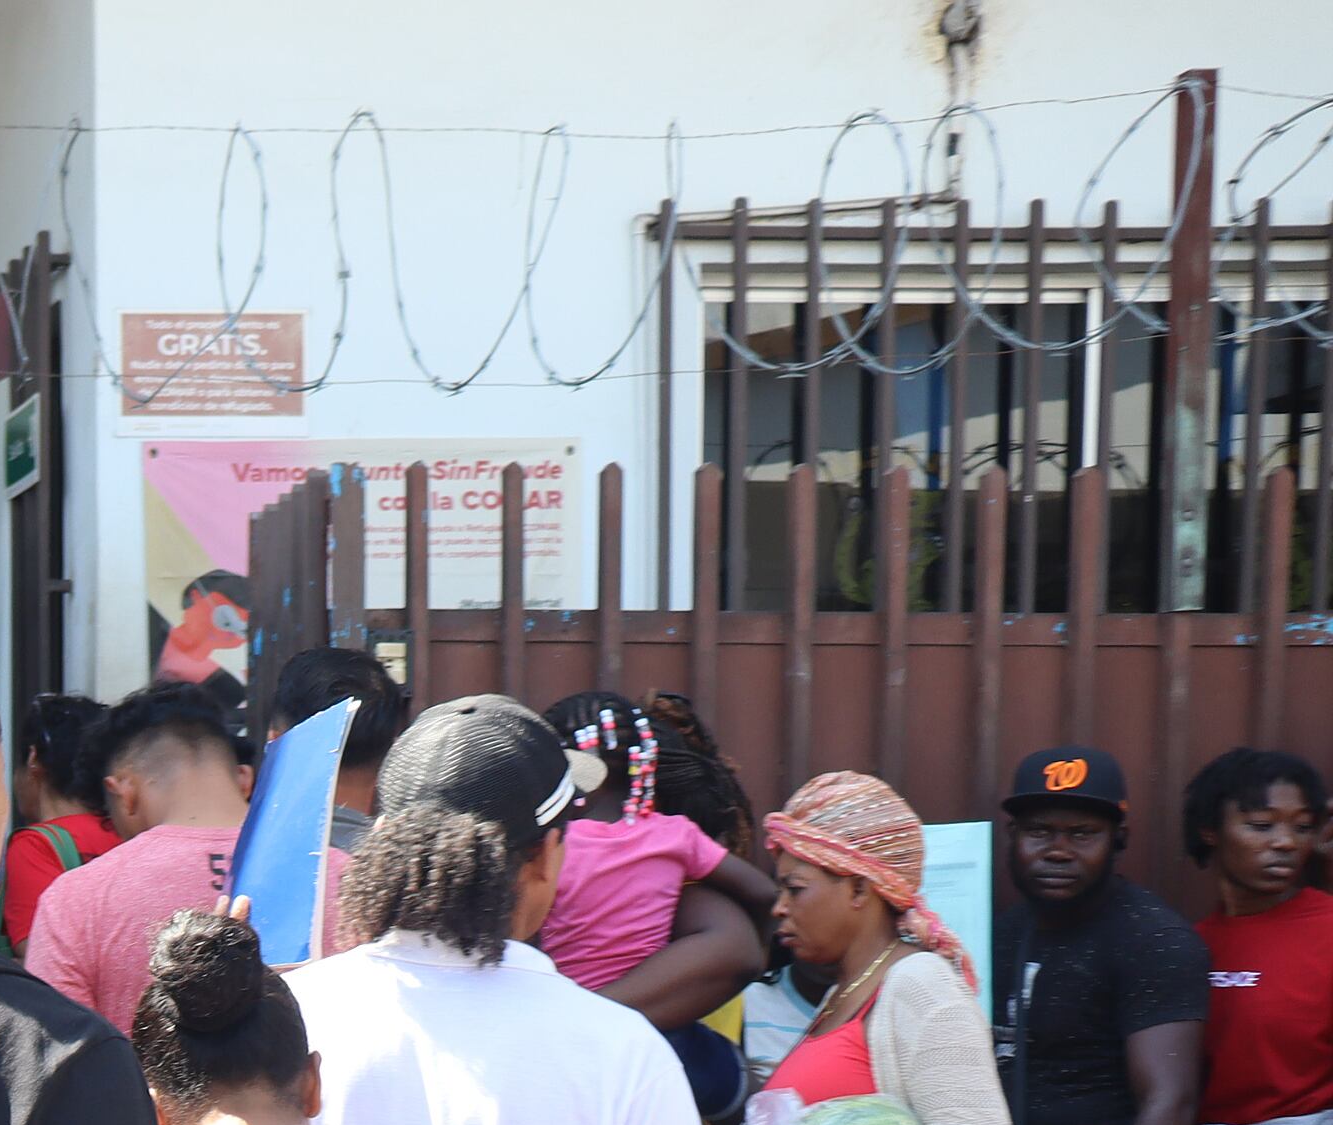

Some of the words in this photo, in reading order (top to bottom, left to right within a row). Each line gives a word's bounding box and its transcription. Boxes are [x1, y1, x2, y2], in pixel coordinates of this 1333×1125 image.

[157, 333, 268, 356] GRATIS.
[232, 463, 314, 482] Vamo
[378, 495, 409, 511] co
[431, 491, 453, 510] la
[461, 489, 563, 511] COAR
